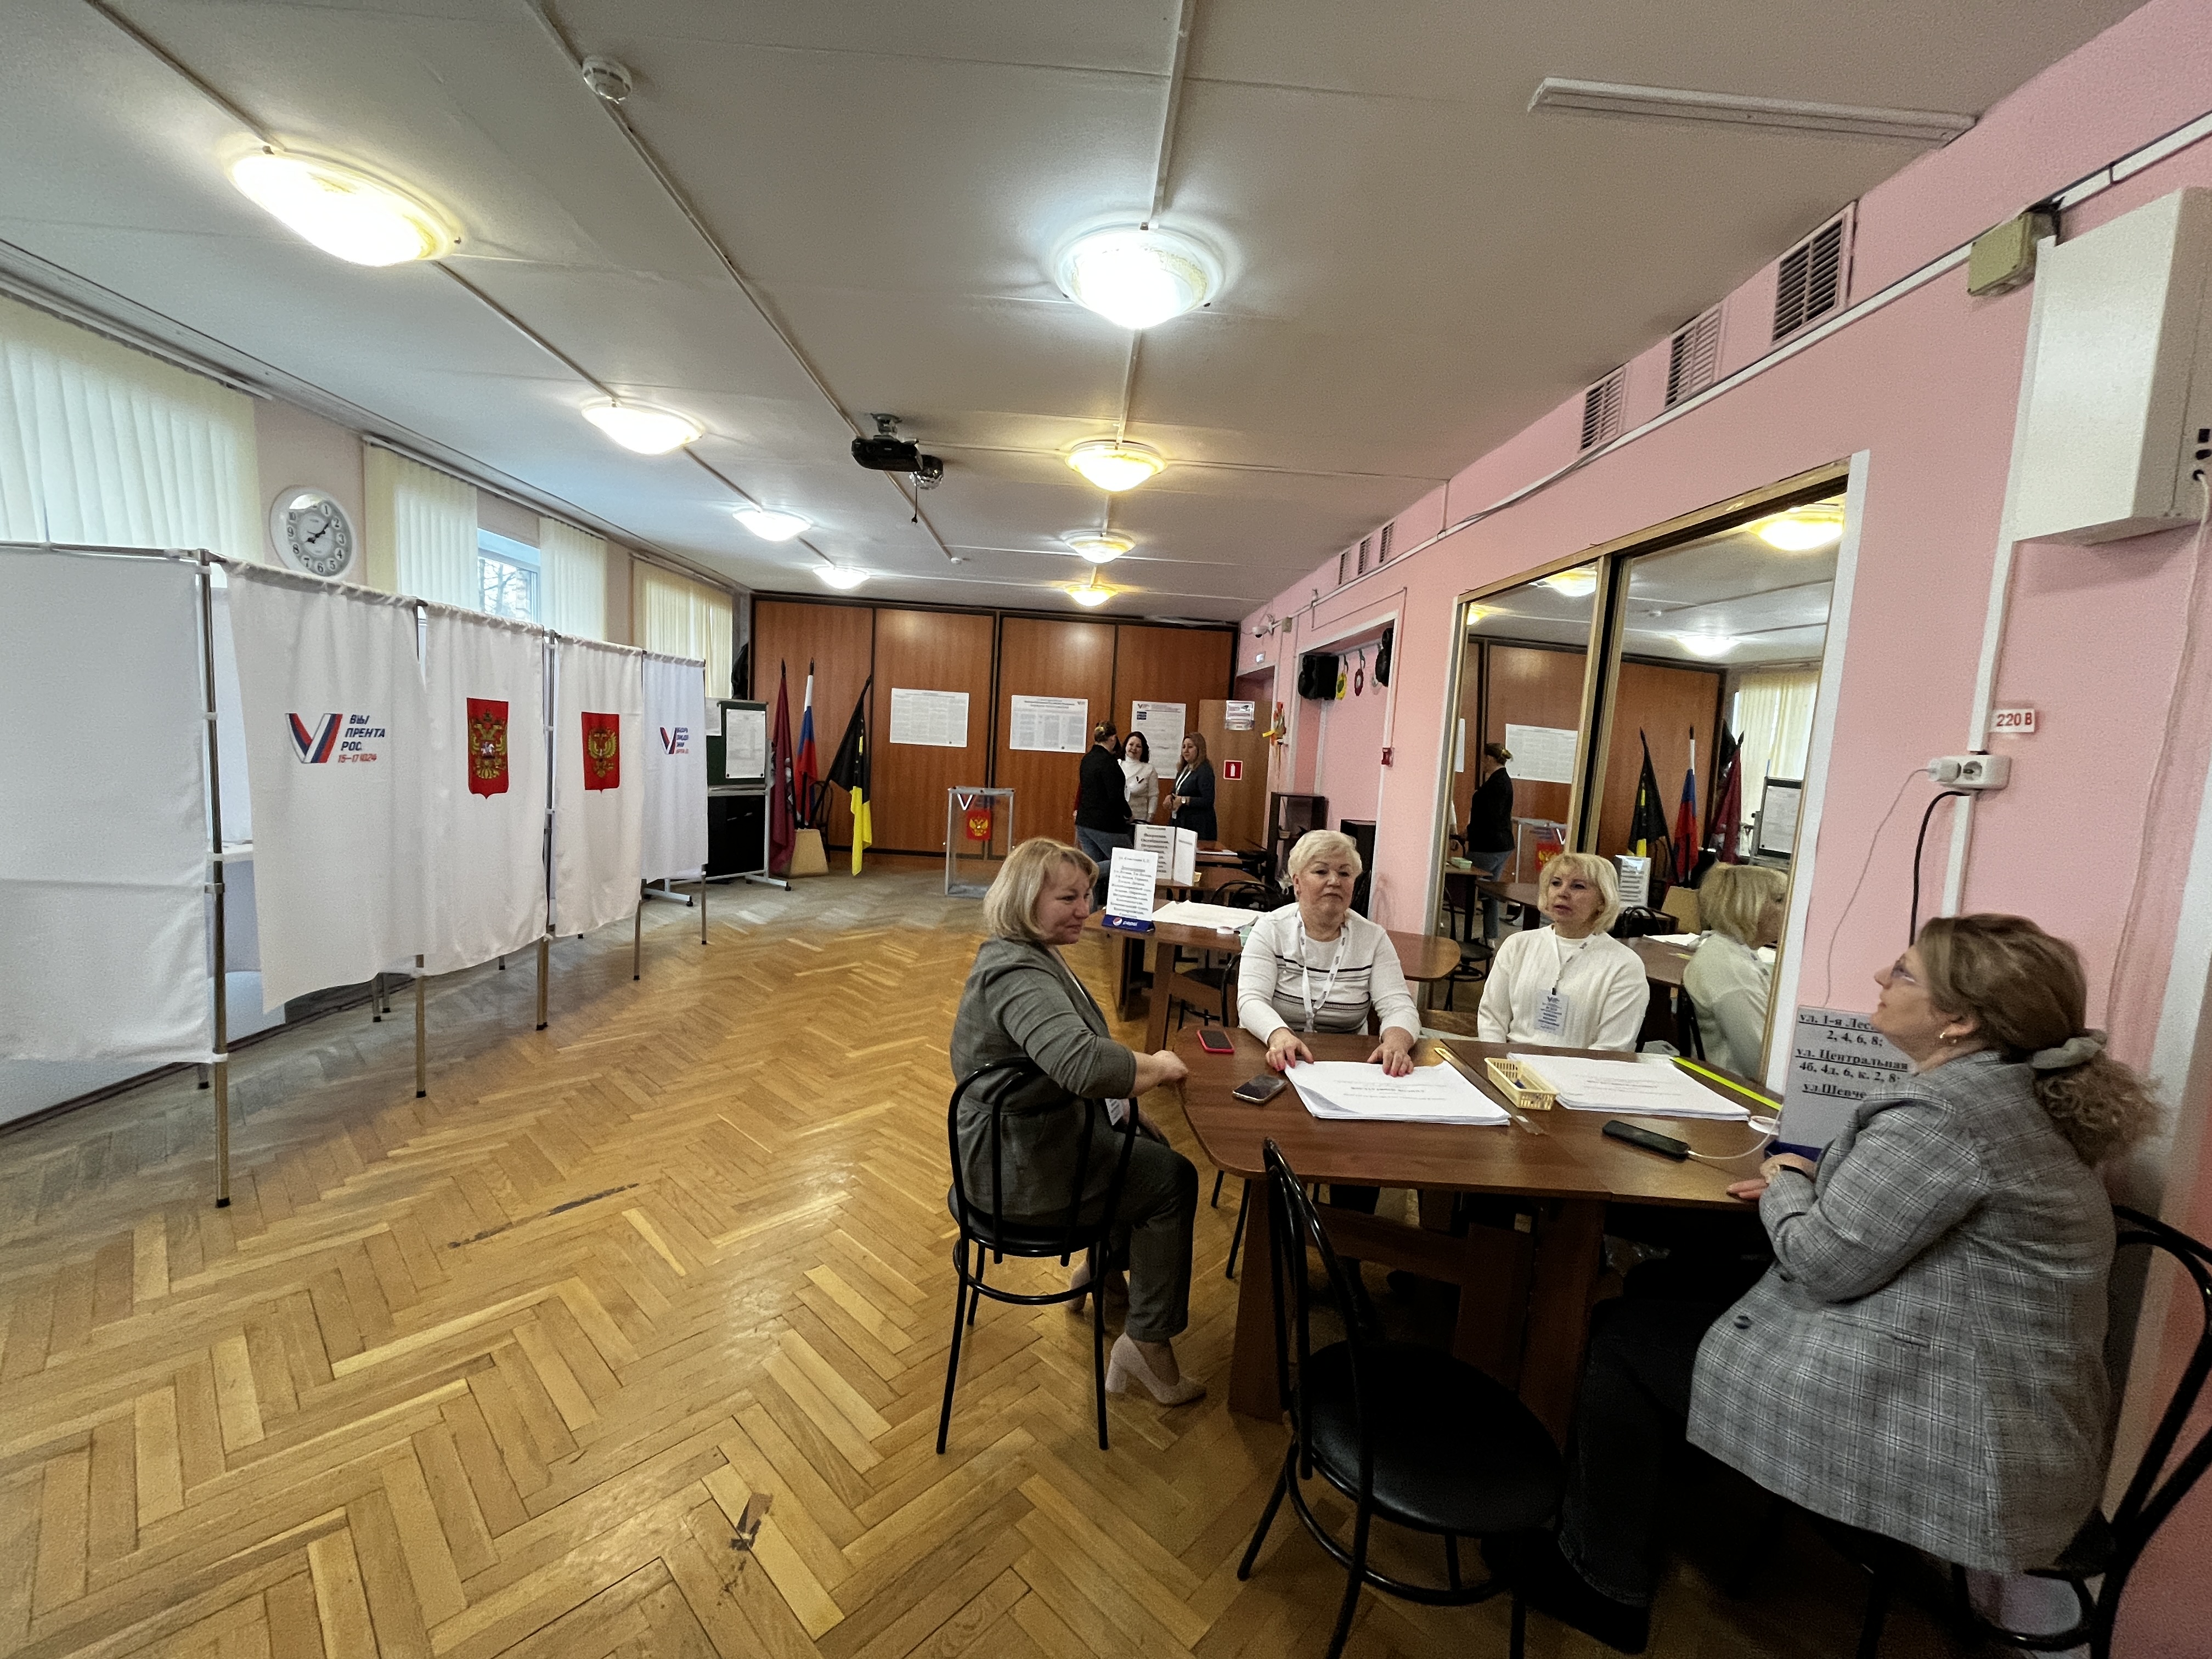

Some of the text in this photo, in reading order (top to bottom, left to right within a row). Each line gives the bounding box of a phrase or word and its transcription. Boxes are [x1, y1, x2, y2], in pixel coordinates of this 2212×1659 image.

[325, 505, 329, 515] 1
[334, 517, 340, 528] 2
[287, 526, 294, 537] 9
[338, 534, 345, 545] 3
[292, 544, 300, 555] 8
[336, 549, 342, 559] 4
[303, 557, 309, 567] 7
[317, 562, 324, 573] 6
[329, 560, 336, 570] 5
[1996, 712, 2033, 727] 220 В
[1823, 1015, 1842, 1026] 1-я
[1846, 1017, 1874, 1030] Лес
[1826, 1030, 1837, 1042] 2,
[1841, 1032, 1853, 1043] 4,
[1857, 1034, 1867, 1045] 6,
[1820, 1049, 1908, 1070] Центральная
